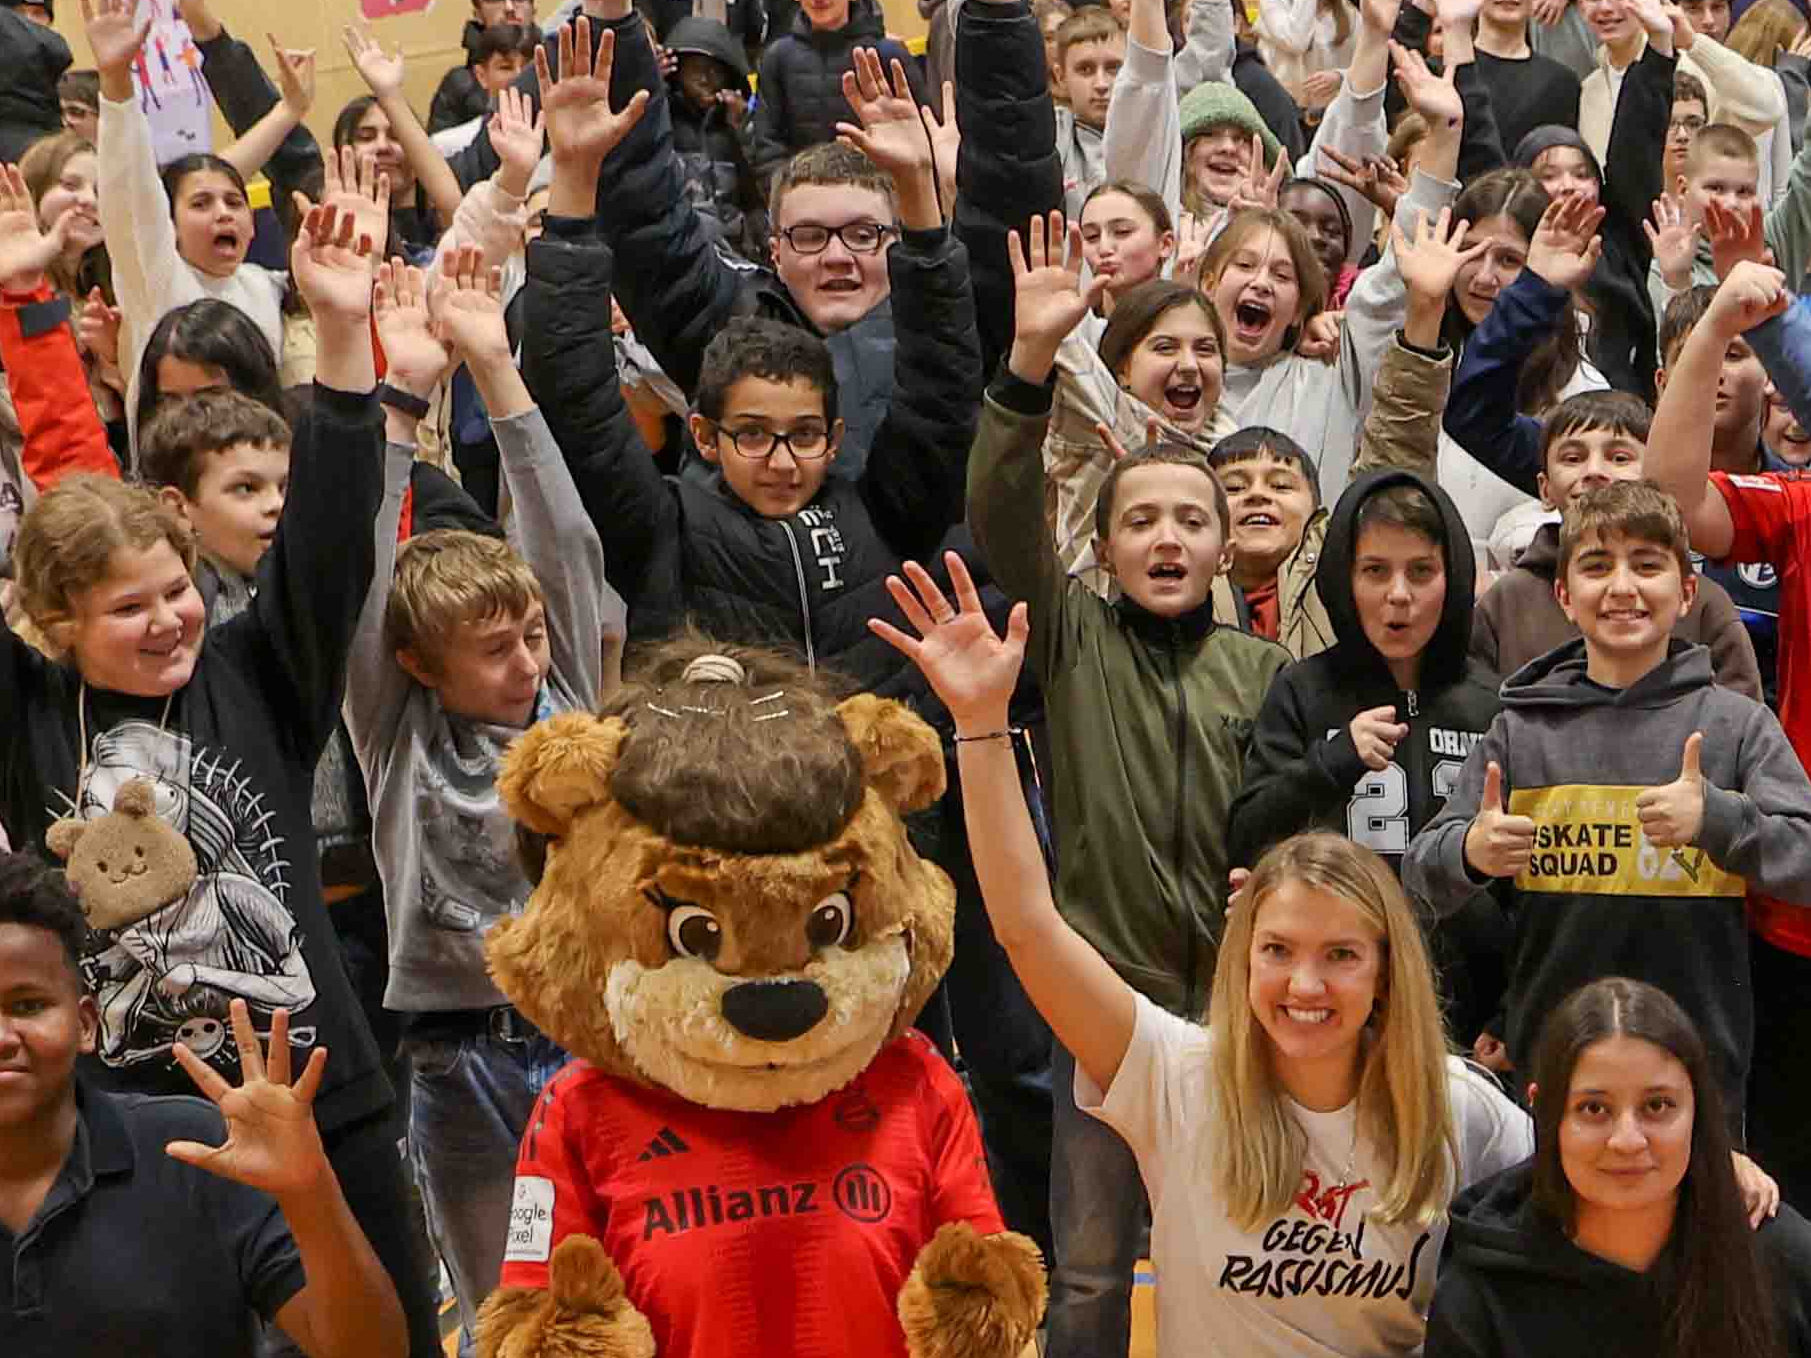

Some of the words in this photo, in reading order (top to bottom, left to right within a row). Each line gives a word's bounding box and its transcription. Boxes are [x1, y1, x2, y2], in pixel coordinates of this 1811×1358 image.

[1530, 854, 1618, 877] SQUAD
[643, 1181, 820, 1242] Allianz
[1263, 1213, 1365, 1259] GEGEN
[1219, 1233, 1430, 1301] RASSISMUS
